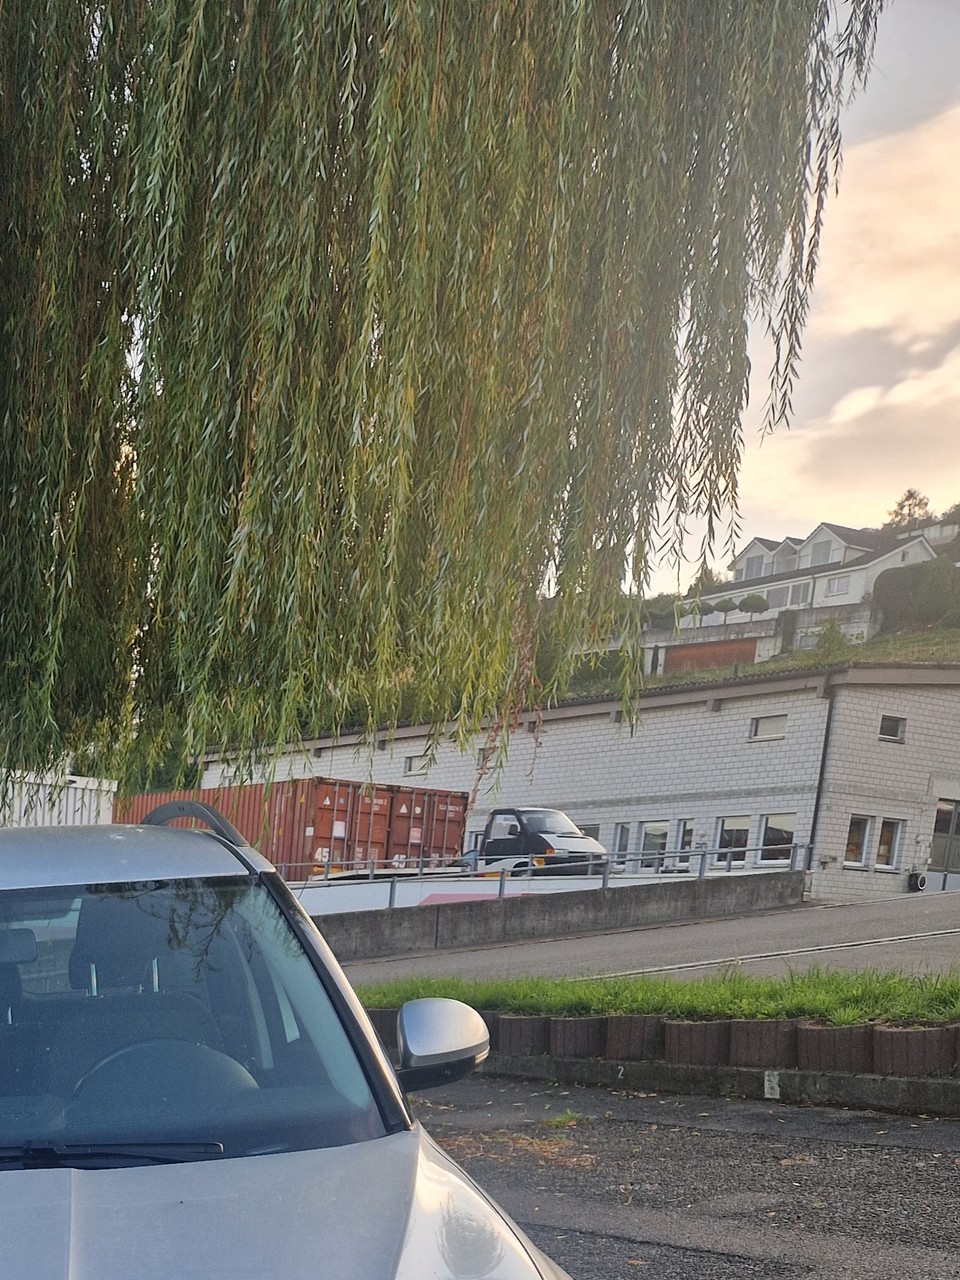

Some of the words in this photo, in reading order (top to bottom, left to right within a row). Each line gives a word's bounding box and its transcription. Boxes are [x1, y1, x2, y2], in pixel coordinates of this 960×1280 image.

[315, 847, 330, 862] 45
[392, 854, 407, 869] 45
[617, 1066, 625, 1079] 2
